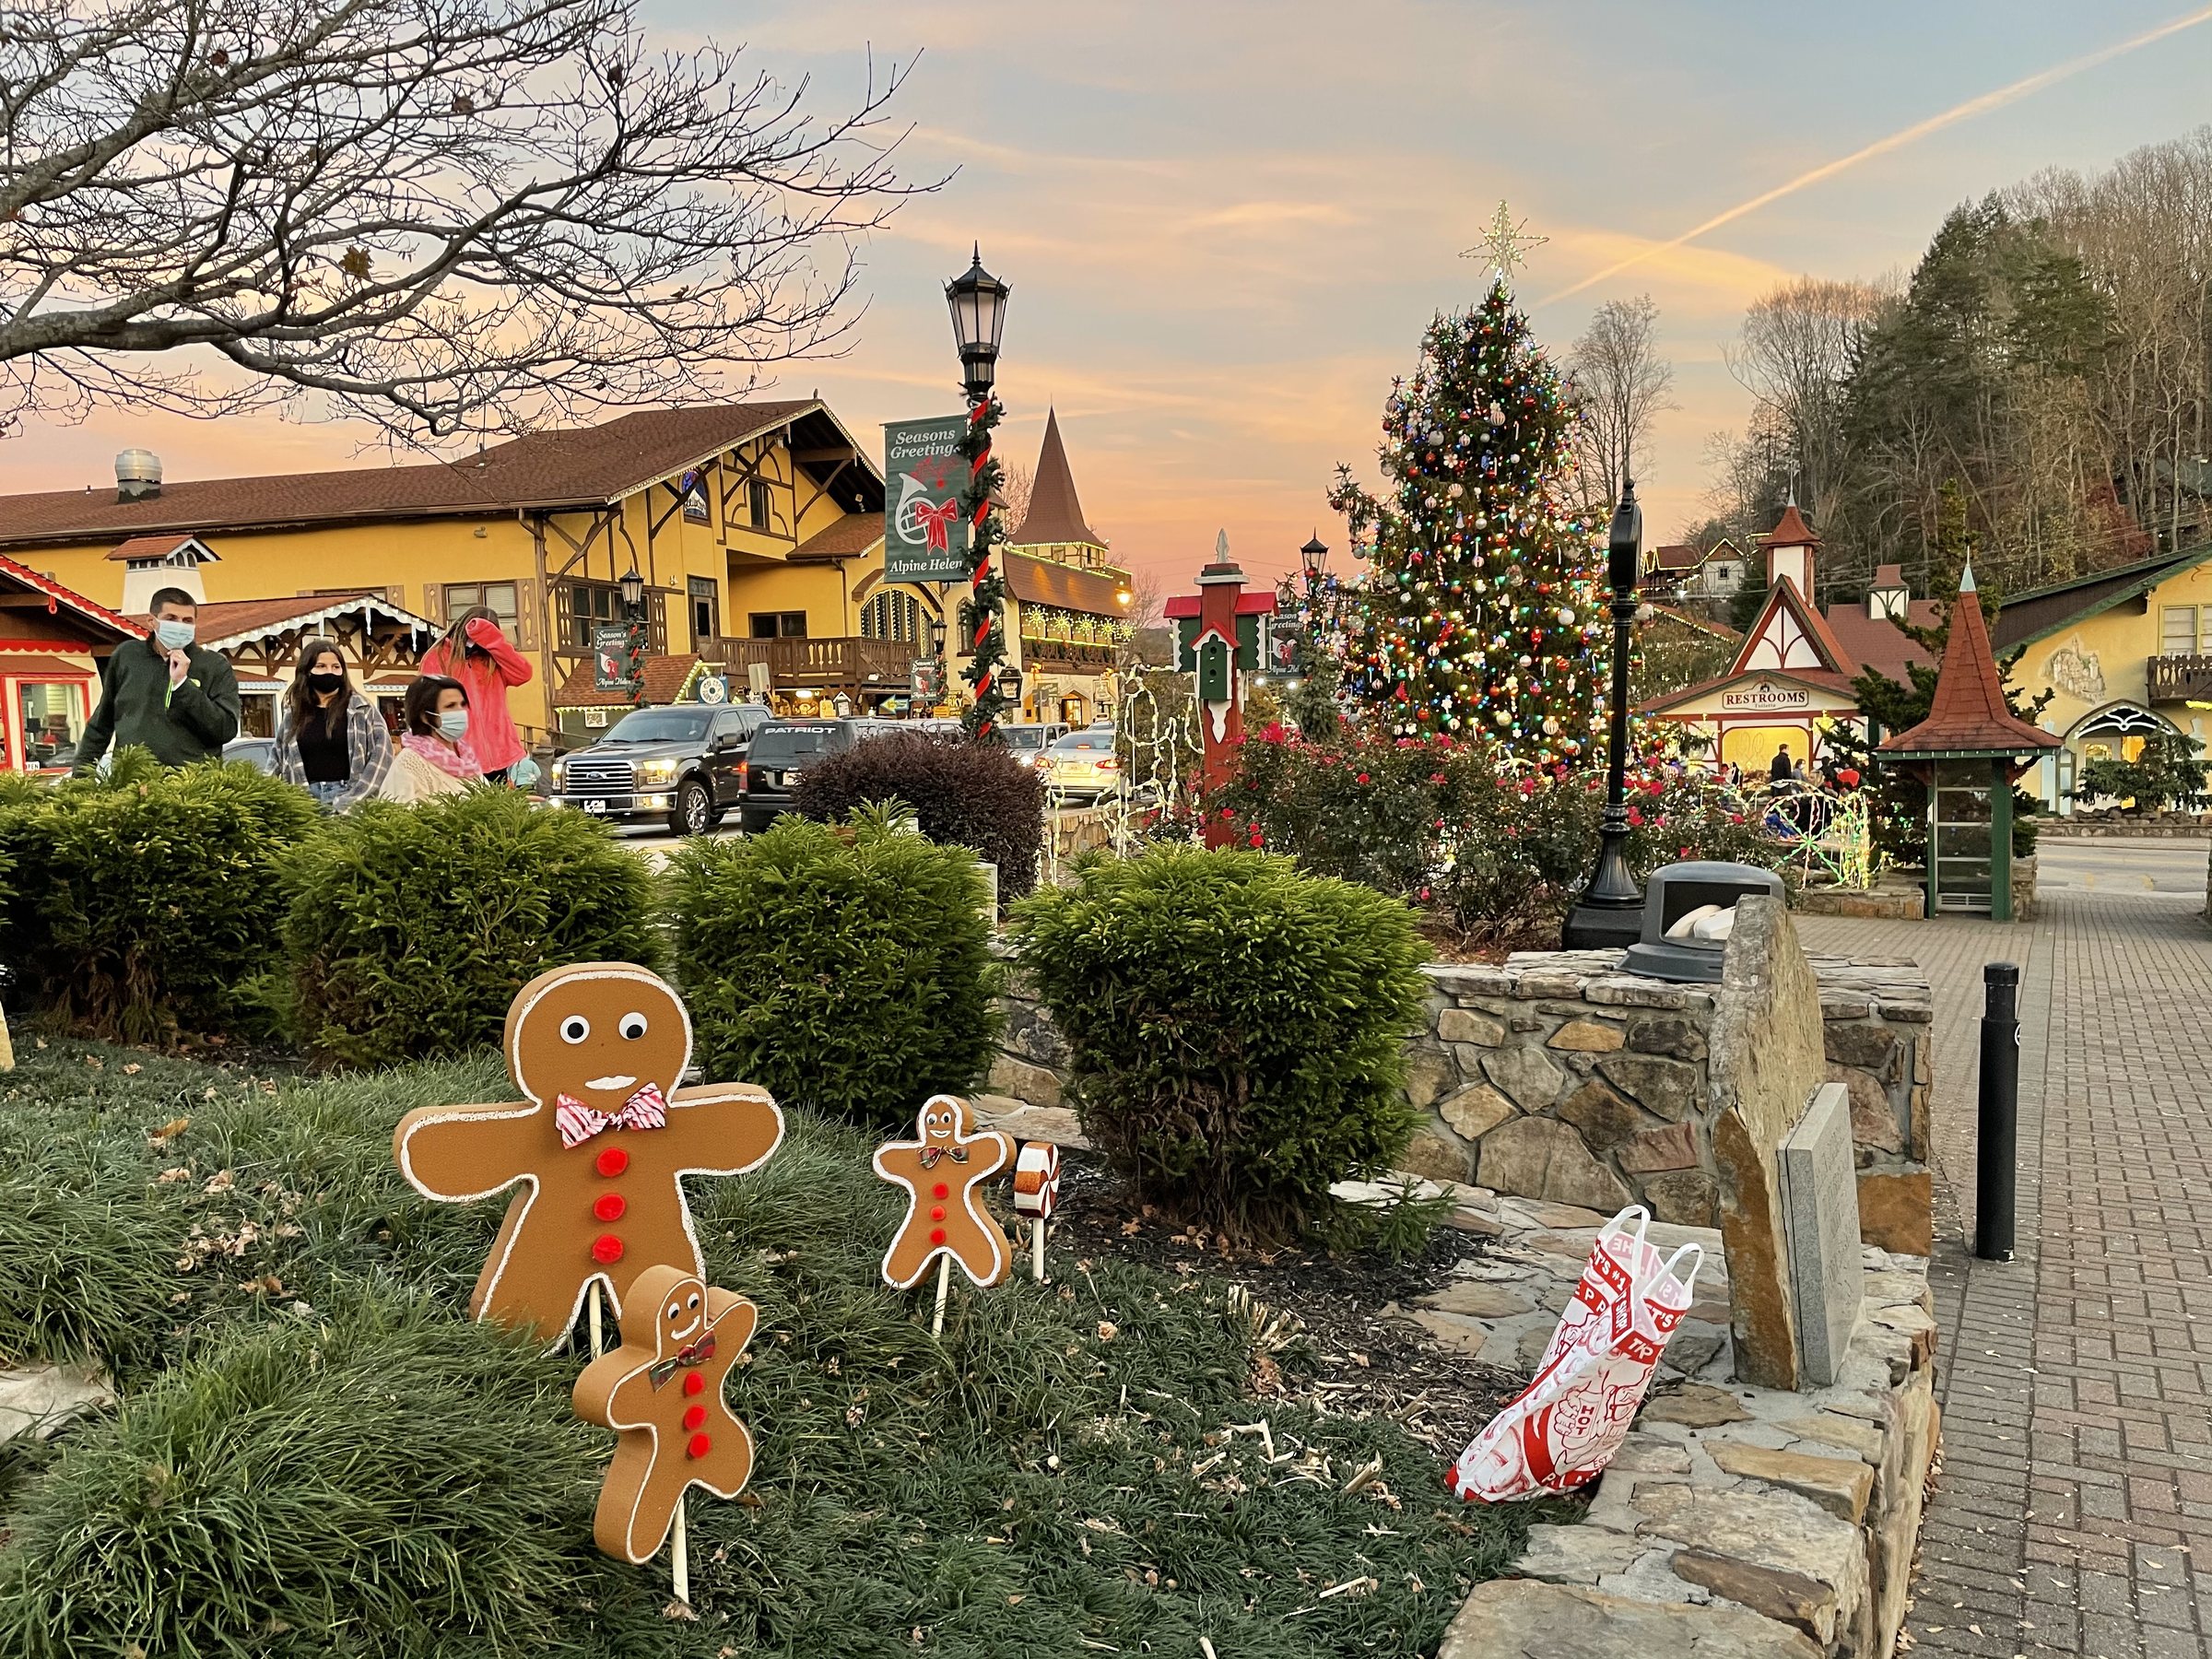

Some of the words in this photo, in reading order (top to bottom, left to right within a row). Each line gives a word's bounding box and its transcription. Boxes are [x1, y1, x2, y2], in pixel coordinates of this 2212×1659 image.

[895, 429, 957, 445] Seasons
[889, 559, 927, 575] Alpine
[928, 558, 963, 571] Helen
[595, 636, 629, 650] Greeting
[1726, 692, 1806, 705] RESTROOMS
[764, 726, 836, 735] PATRIOT
[1576, 1405, 1595, 1436] HOT
